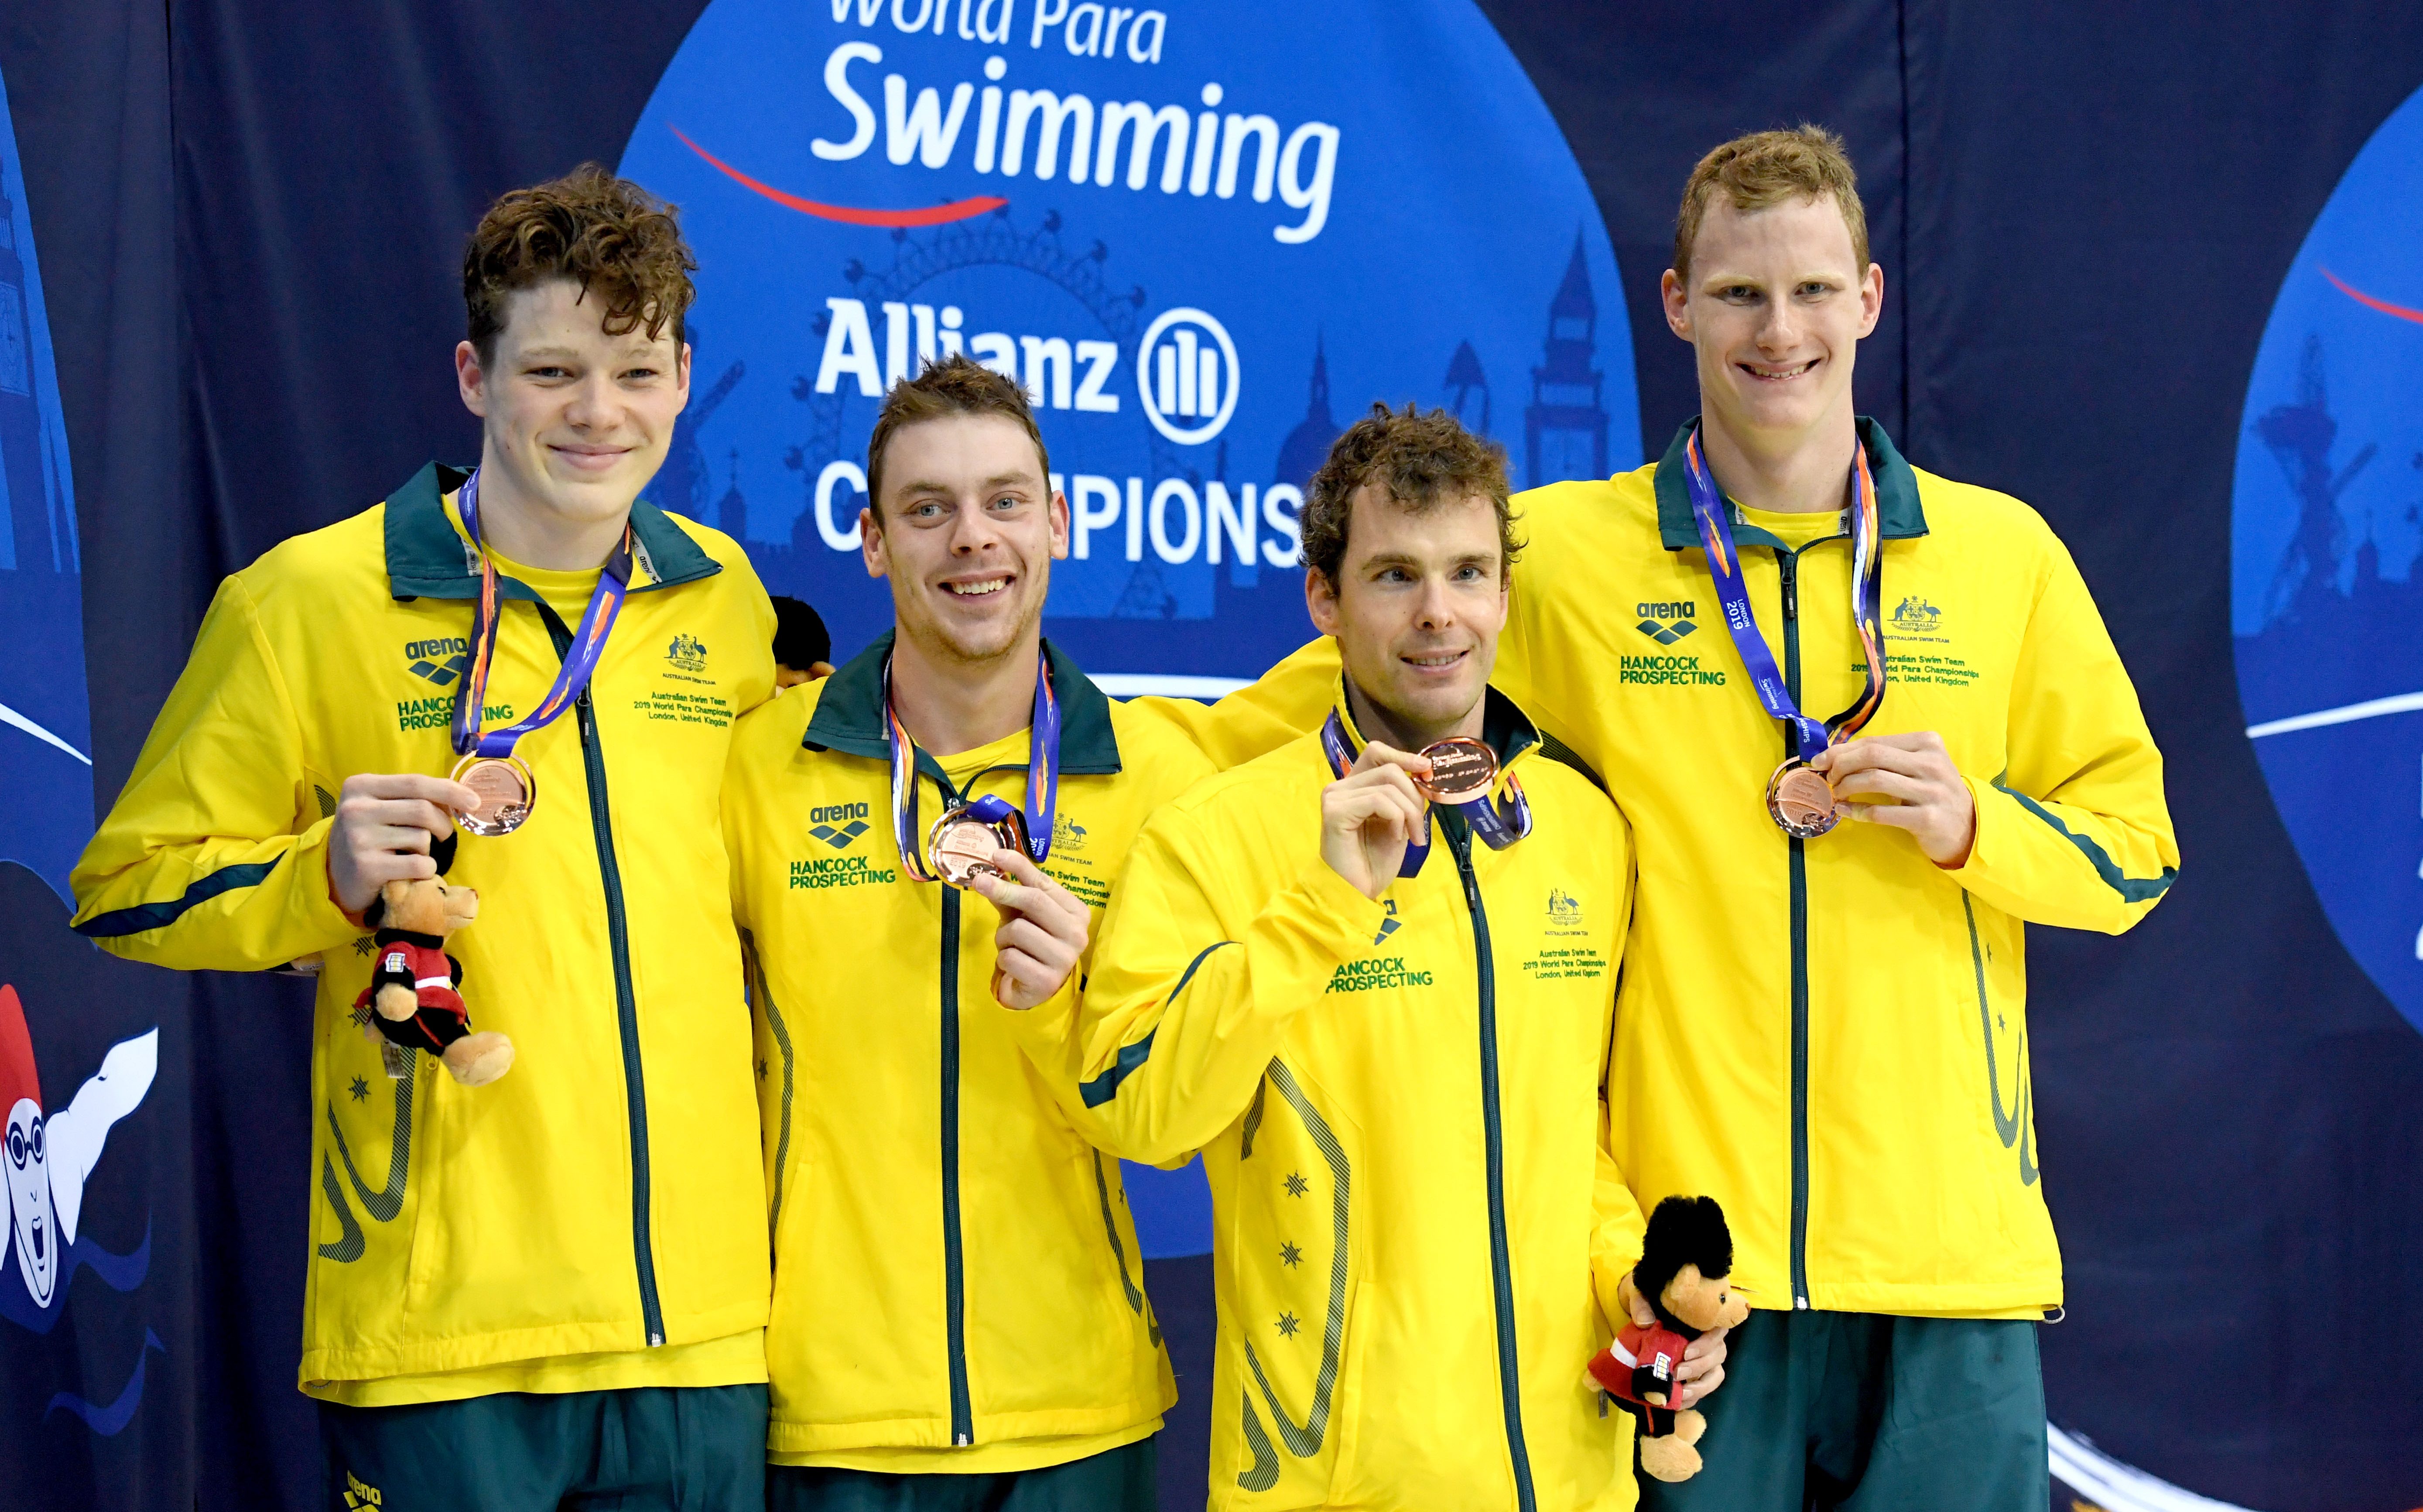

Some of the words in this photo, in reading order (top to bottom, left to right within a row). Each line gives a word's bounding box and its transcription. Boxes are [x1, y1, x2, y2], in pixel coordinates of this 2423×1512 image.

[1030, 0, 1167, 64] Para
[810, 41, 1340, 244] Swimming
[1636, 601, 1695, 619] arena
[1726, 601, 1743, 630] 2019
[1738, 599, 1750, 627] LONDON
[406, 637, 468, 660] arena
[1620, 656, 1699, 670] HANCOCK
[1885, 655, 1916, 663] stralian
[1919, 655, 1942, 664] Swim
[1944, 657, 1965, 667] Team
[1901, 664, 1921, 673] Para
[662, 673, 691, 681] AUSTRALIAN
[1620, 670, 1726, 686] PROSPECTING
[1935, 677, 1969, 687] Kingdom
[651, 691, 688, 702] Australian
[689, 694, 708, 704] Swim
[710, 697, 727, 707] Team
[1761, 679, 1780, 709] Swimming
[633, 701, 650, 709] 2019
[653, 701, 674, 711] World
[677, 703, 692, 712] Para
[648, 712, 678, 722] London,
[680, 713, 702, 723] United
[705, 716, 728, 728] Kingdom
[810, 802, 868, 823] arena
[1786, 807, 1802, 817] 2019
[1036, 838, 1046, 856] LONDON
[790, 856, 868, 875] HANCOCK
[1060, 855, 1075, 863] SWIM
[790, 869, 896, 889] PROSPECTING
[1057, 871, 1080, 883] Swim
[1083, 876, 1105, 888] Team
[1539, 948, 1570, 958] Australian
[1571, 948, 1586, 957] Swim
[1333, 957, 1406, 978] ANCOCK
[1523, 961, 1538, 970] 2019
[1540, 960, 1560, 968] World
[1535, 970, 1562, 979] London,
[1564, 969, 1581, 978] United
